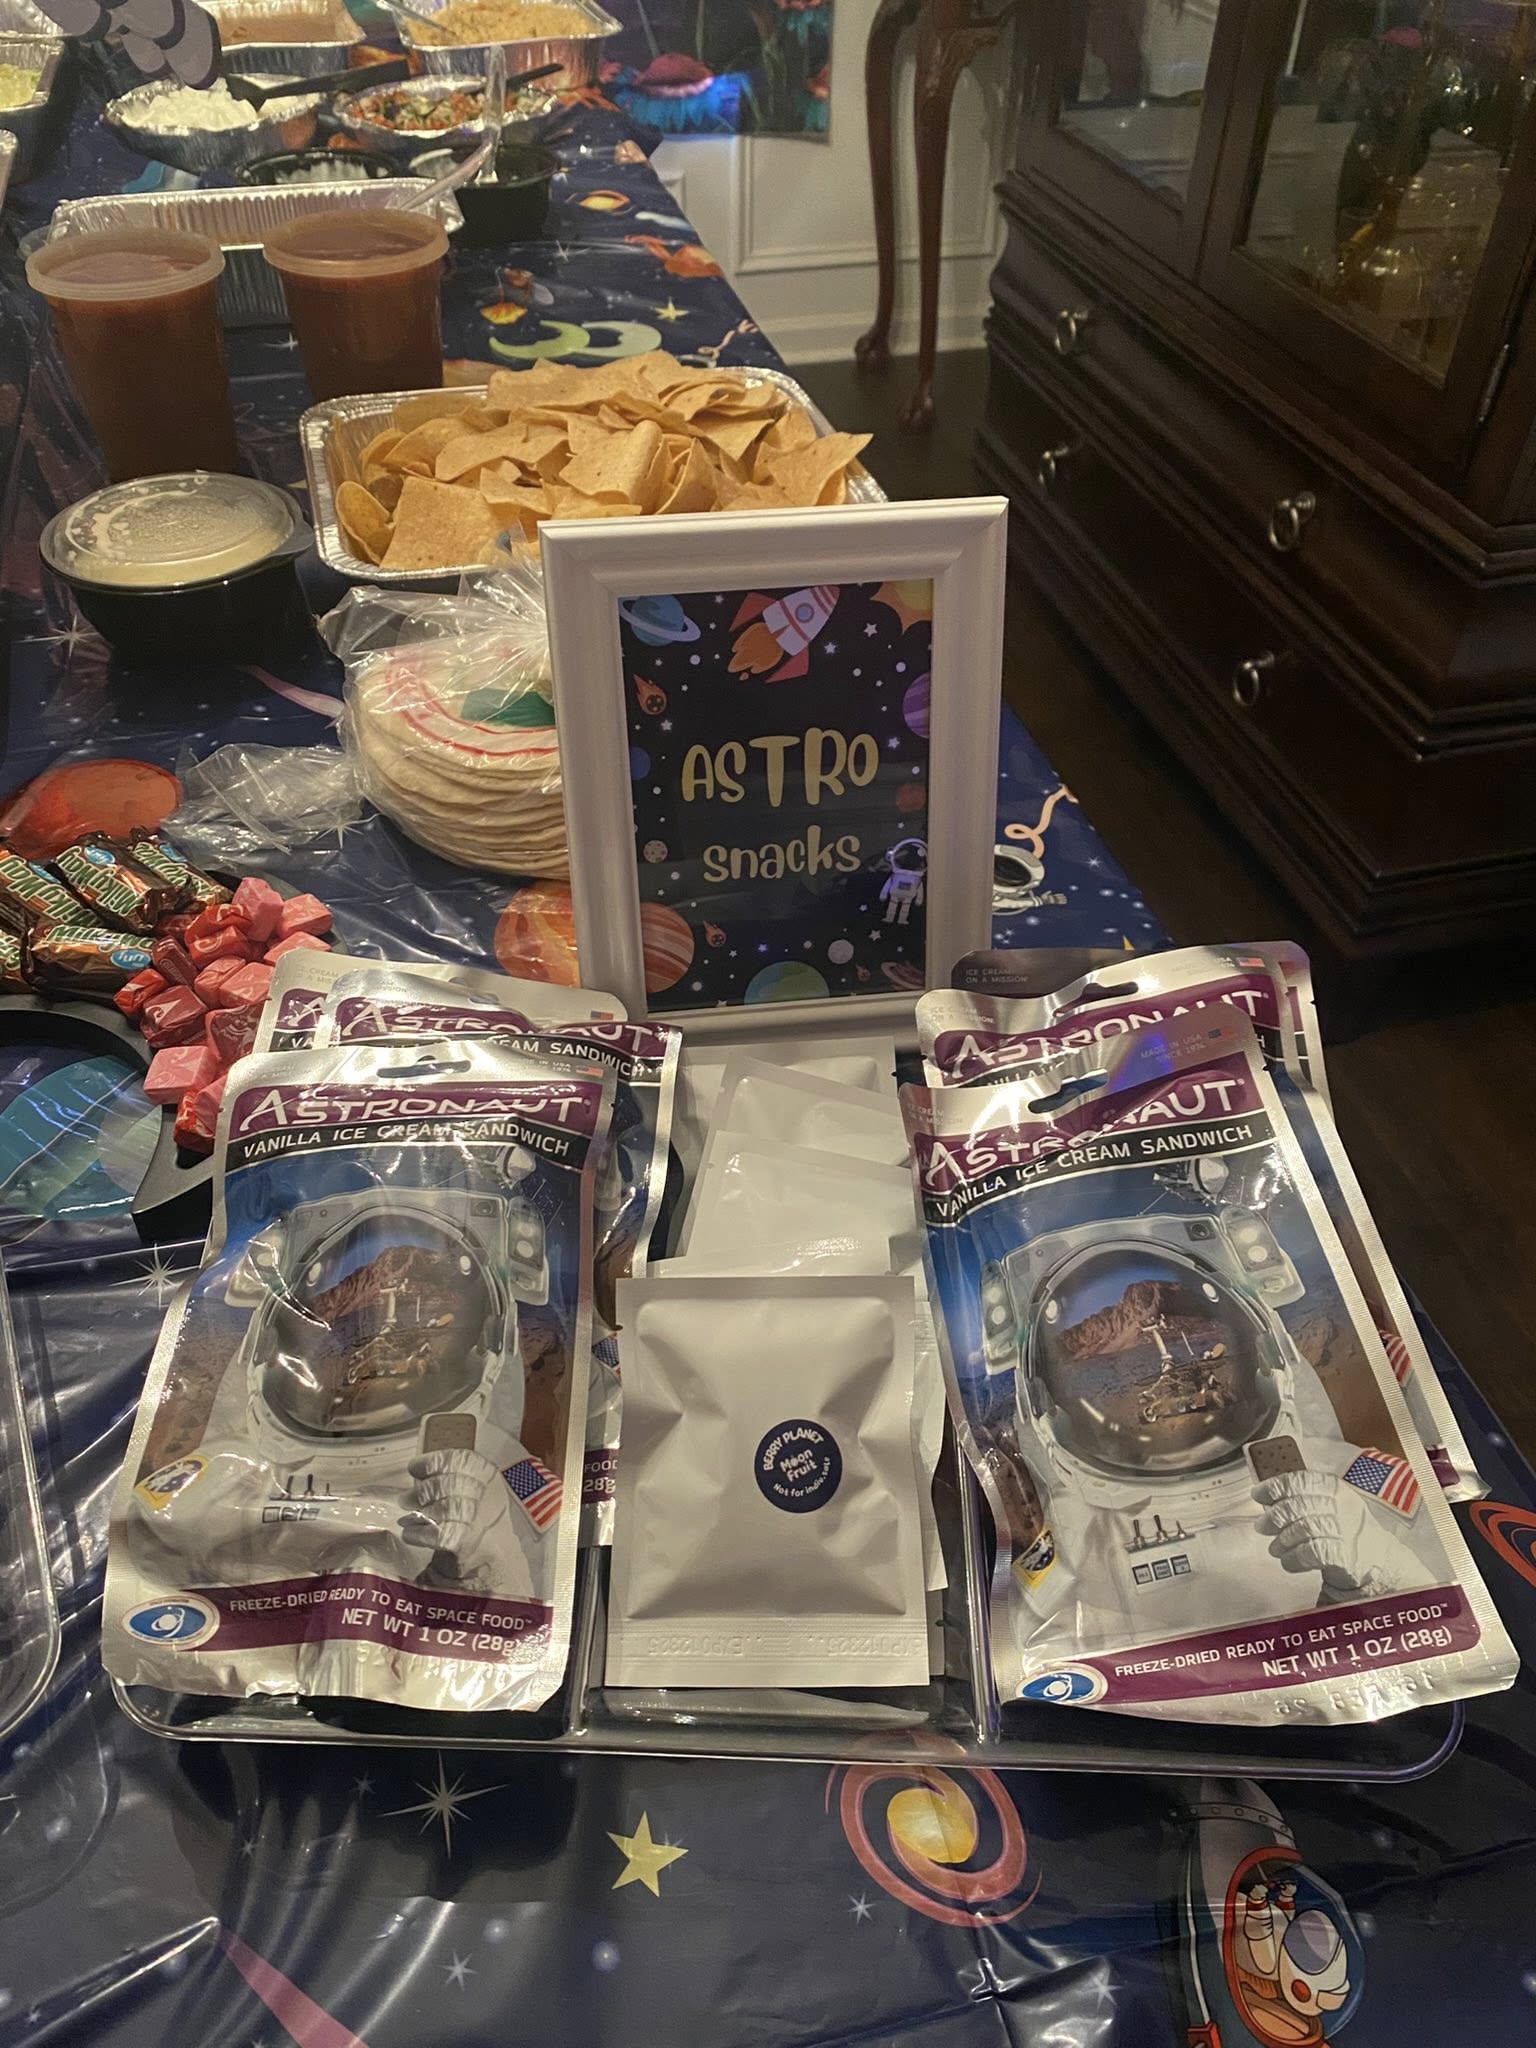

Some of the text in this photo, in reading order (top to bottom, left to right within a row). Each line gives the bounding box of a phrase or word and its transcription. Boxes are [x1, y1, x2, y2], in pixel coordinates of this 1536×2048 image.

[681, 727, 879, 807] ASTRO
[703, 825, 861, 882] snacks
[119, 949, 145, 963] fun
[240, 1089, 583, 1131] ASTRONAUT
[244, 1123, 570, 1158] VANILLA ICE CREAM SANDWICH
[936, 1124, 1252, 1217] VANILLA ICE CREAM SANDWICH
[763, 1427, 824, 1471] BERRY PLANET
[780, 1449, 813, 1472] Moon
[773, 1483, 789, 1496] Not
[791, 1488, 804, 1497] for
[230, 1590, 327, 1611] FREEZE-DRIED
[328, 1588, 365, 1601] READY
[371, 1590, 391, 1605] TO
[395, 1599, 423, 1616] EAT
[427, 1607, 477, 1625] SPACE
[341, 1608, 378, 1627] NET
[383, 1613, 414, 1637] WT
[418, 1626, 431, 1642] 1
[437, 1628, 468, 1647] OZ
[1115, 1649, 1220, 1677] FREEZE-DRIED
[1227, 1639, 1275, 1660] READY
[1281, 1633, 1303, 1649] TO
[1309, 1625, 1337, 1643] EAT
[1343, 1615, 1394, 1636] SPACE
[1263, 1625, 1452, 1677] NET WT 1 OZ (28g)
